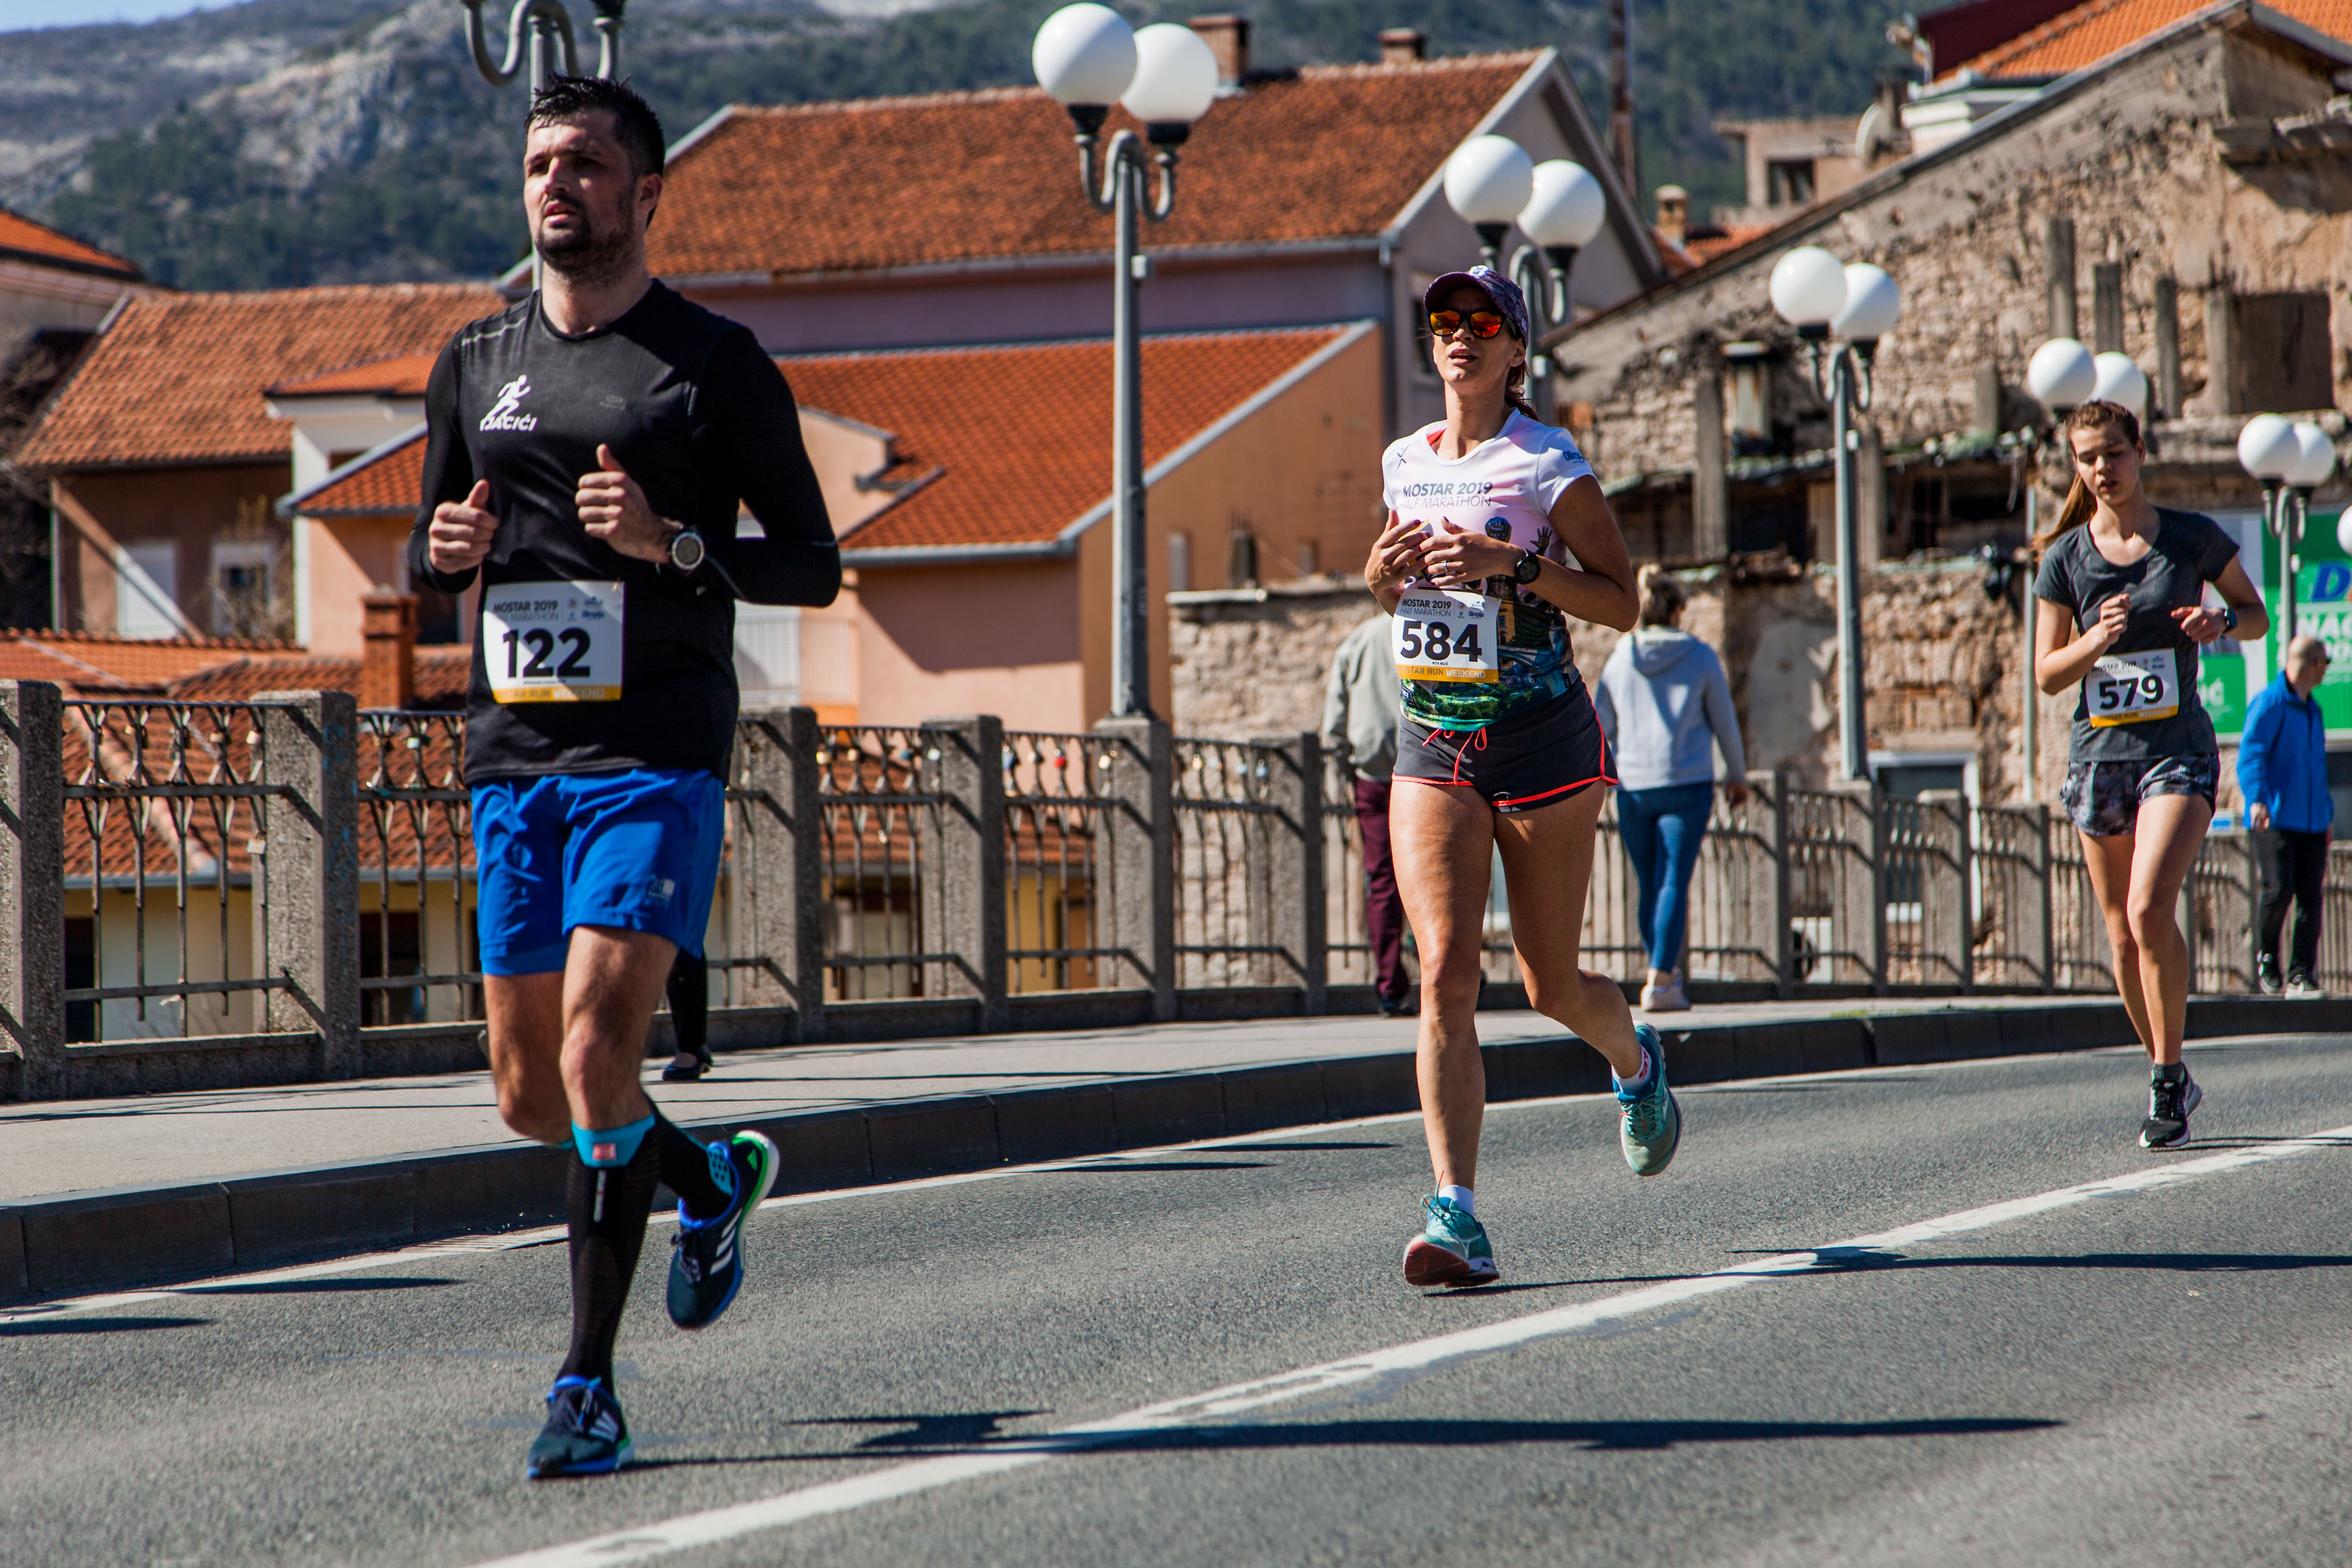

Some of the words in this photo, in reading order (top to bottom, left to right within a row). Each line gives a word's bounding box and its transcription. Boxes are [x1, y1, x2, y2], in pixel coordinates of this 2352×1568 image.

[1403, 483, 1453, 498] MOSTAR
[1454, 482, 1494, 496] 2019
[1399, 497, 1421, 510] HALF
[1421, 495, 1492, 509] MARATHON
[493, 600, 531, 613] MOSTAR
[534, 599, 558, 612] 2019
[1402, 598, 1430, 608] MOSTAR
[1432, 600, 1451, 610] 2019
[1413, 607, 1451, 617] MARATHON
[1400, 620, 1482, 662] 584
[502, 626, 591, 678] 122
[1427, 667, 1444, 676] RUN
[1445, 669, 1486, 679] WEEKEND
[2099, 674, 2164, 711] 579
